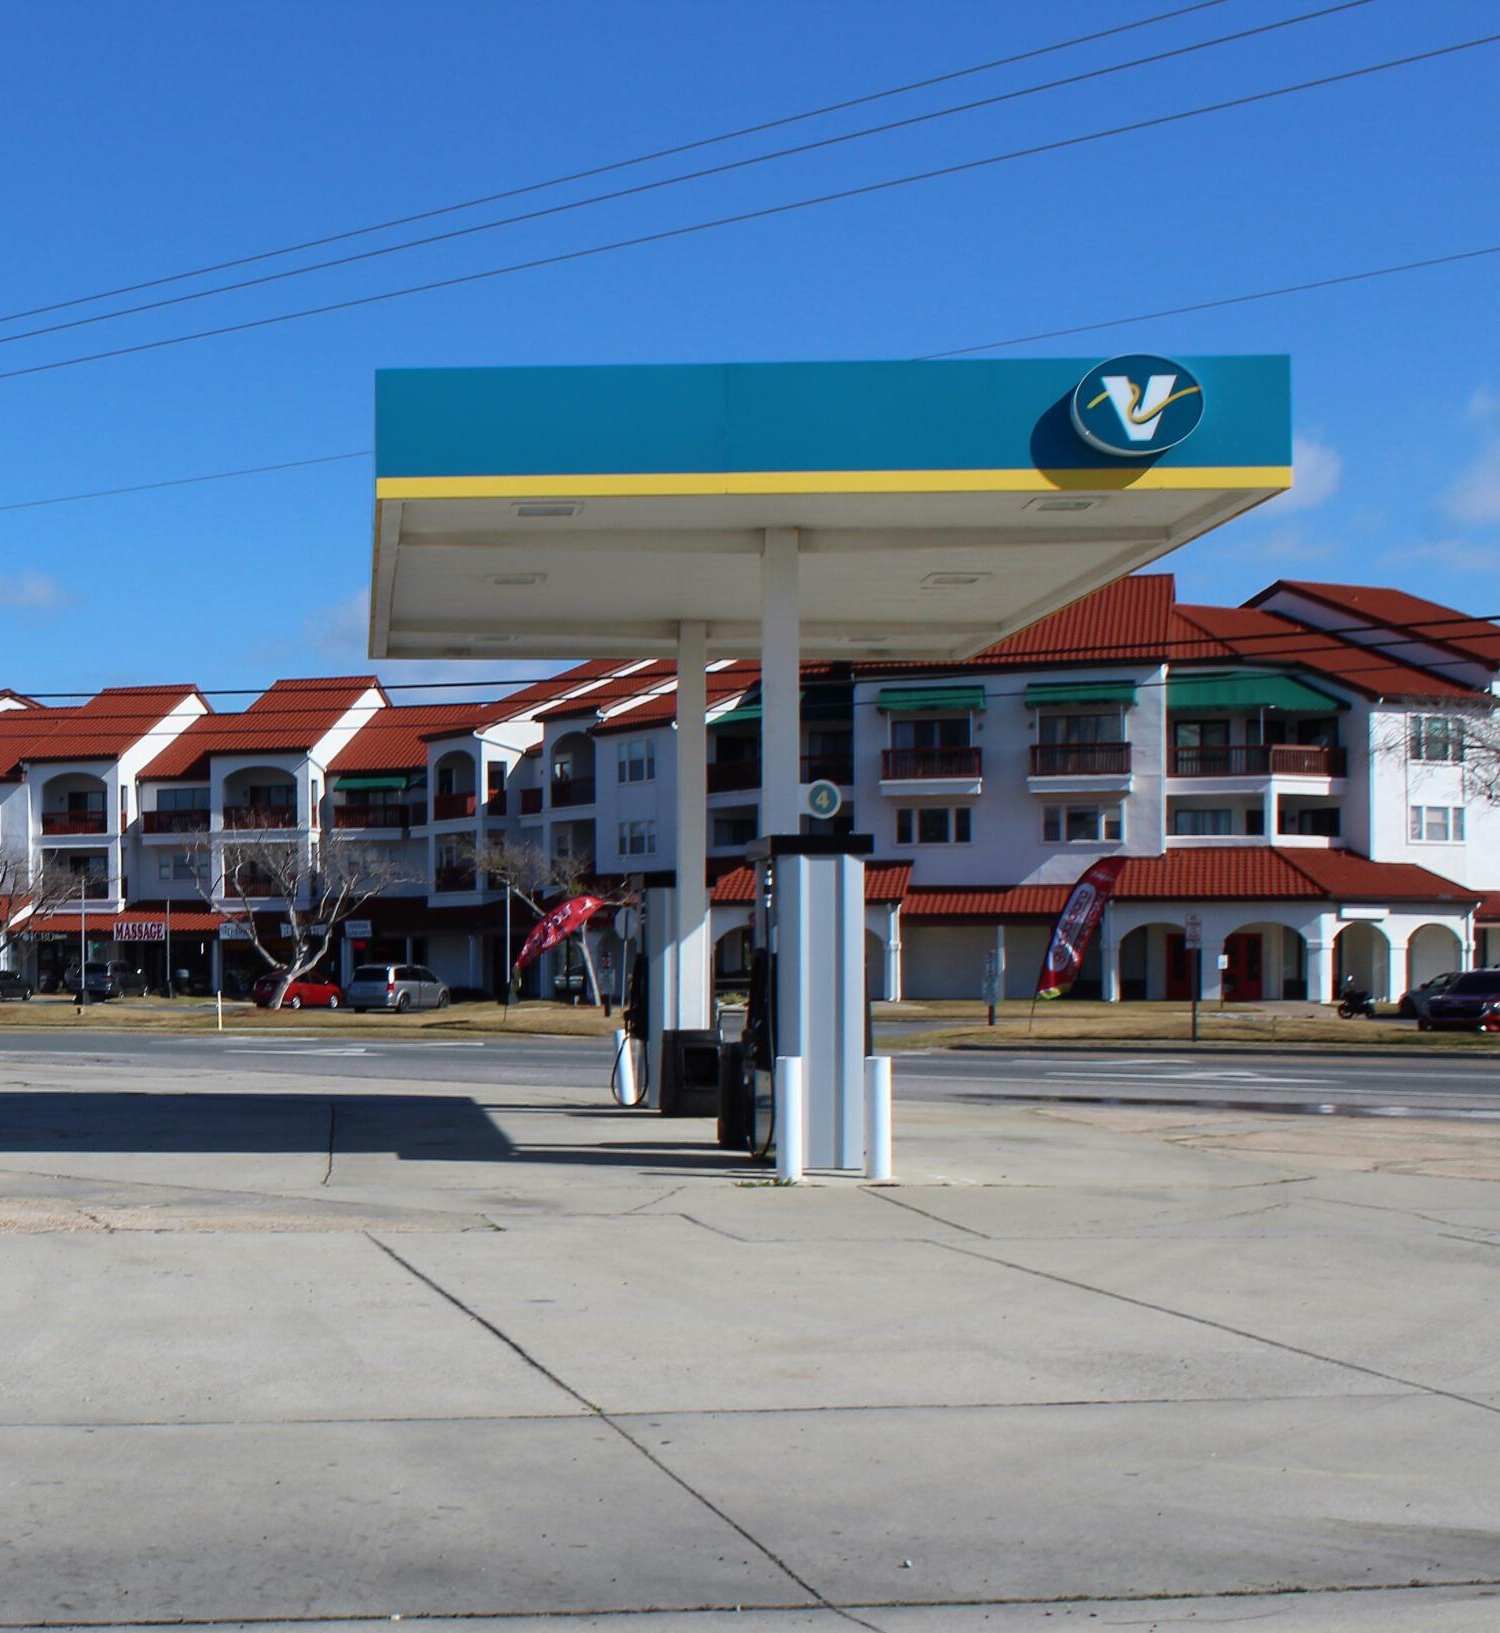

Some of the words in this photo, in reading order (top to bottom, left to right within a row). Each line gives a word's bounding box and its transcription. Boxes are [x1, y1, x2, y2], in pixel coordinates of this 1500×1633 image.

[1101, 374, 1178, 441] V
[816, 789, 830, 809] 4
[115, 923, 165, 939] MASSAGE
